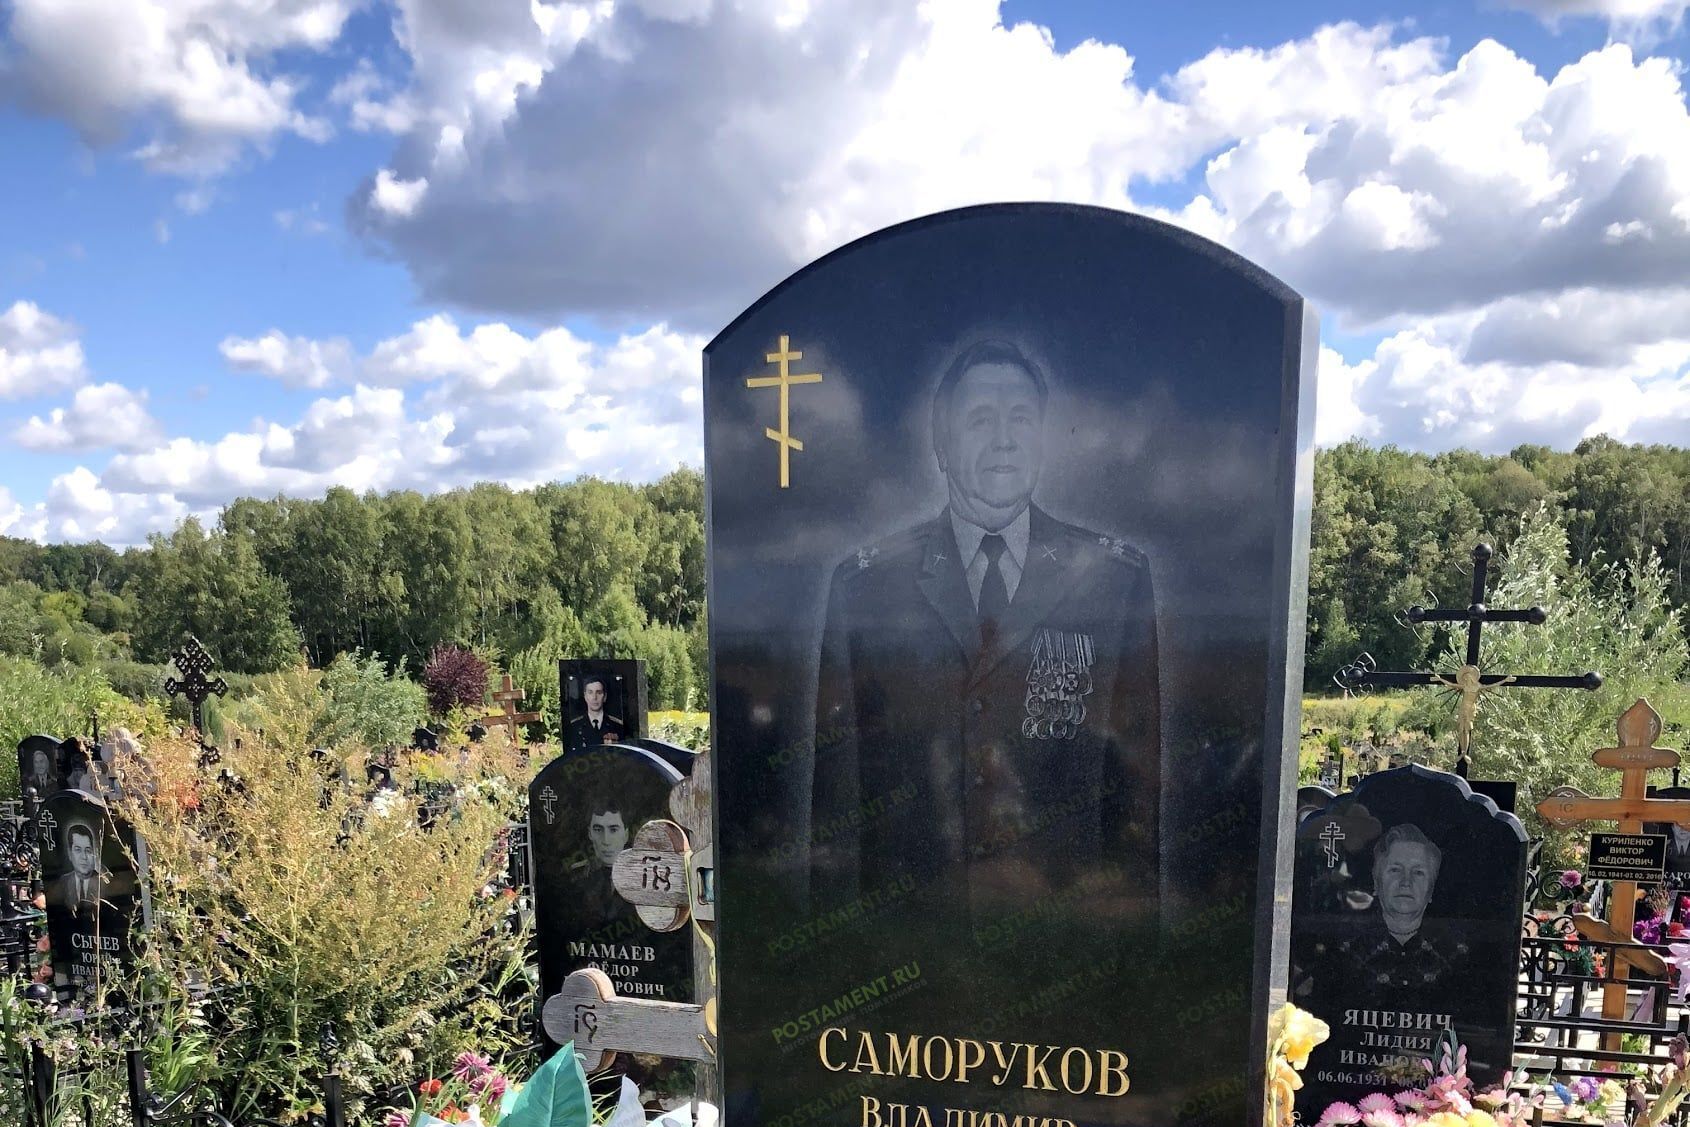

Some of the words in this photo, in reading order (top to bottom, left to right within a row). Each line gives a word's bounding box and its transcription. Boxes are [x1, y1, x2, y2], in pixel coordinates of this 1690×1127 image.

[1601, 836, 1654, 846] КУРИЛЕНКО
[1609, 846, 1645, 855] ВИКТОР
[1597, 855, 1654, 866] ФЁДОРОВИЧ
[71, 932, 120, 951] СЫЧЕВ
[569, 941, 656, 962] МАМАЕВ
[615, 980, 665, 996] РОВИЧ
[1342, 1009, 1452, 1031] ЯЦЕВИЧ
[818, 1027, 1131, 1097] САМОРУКОВ
